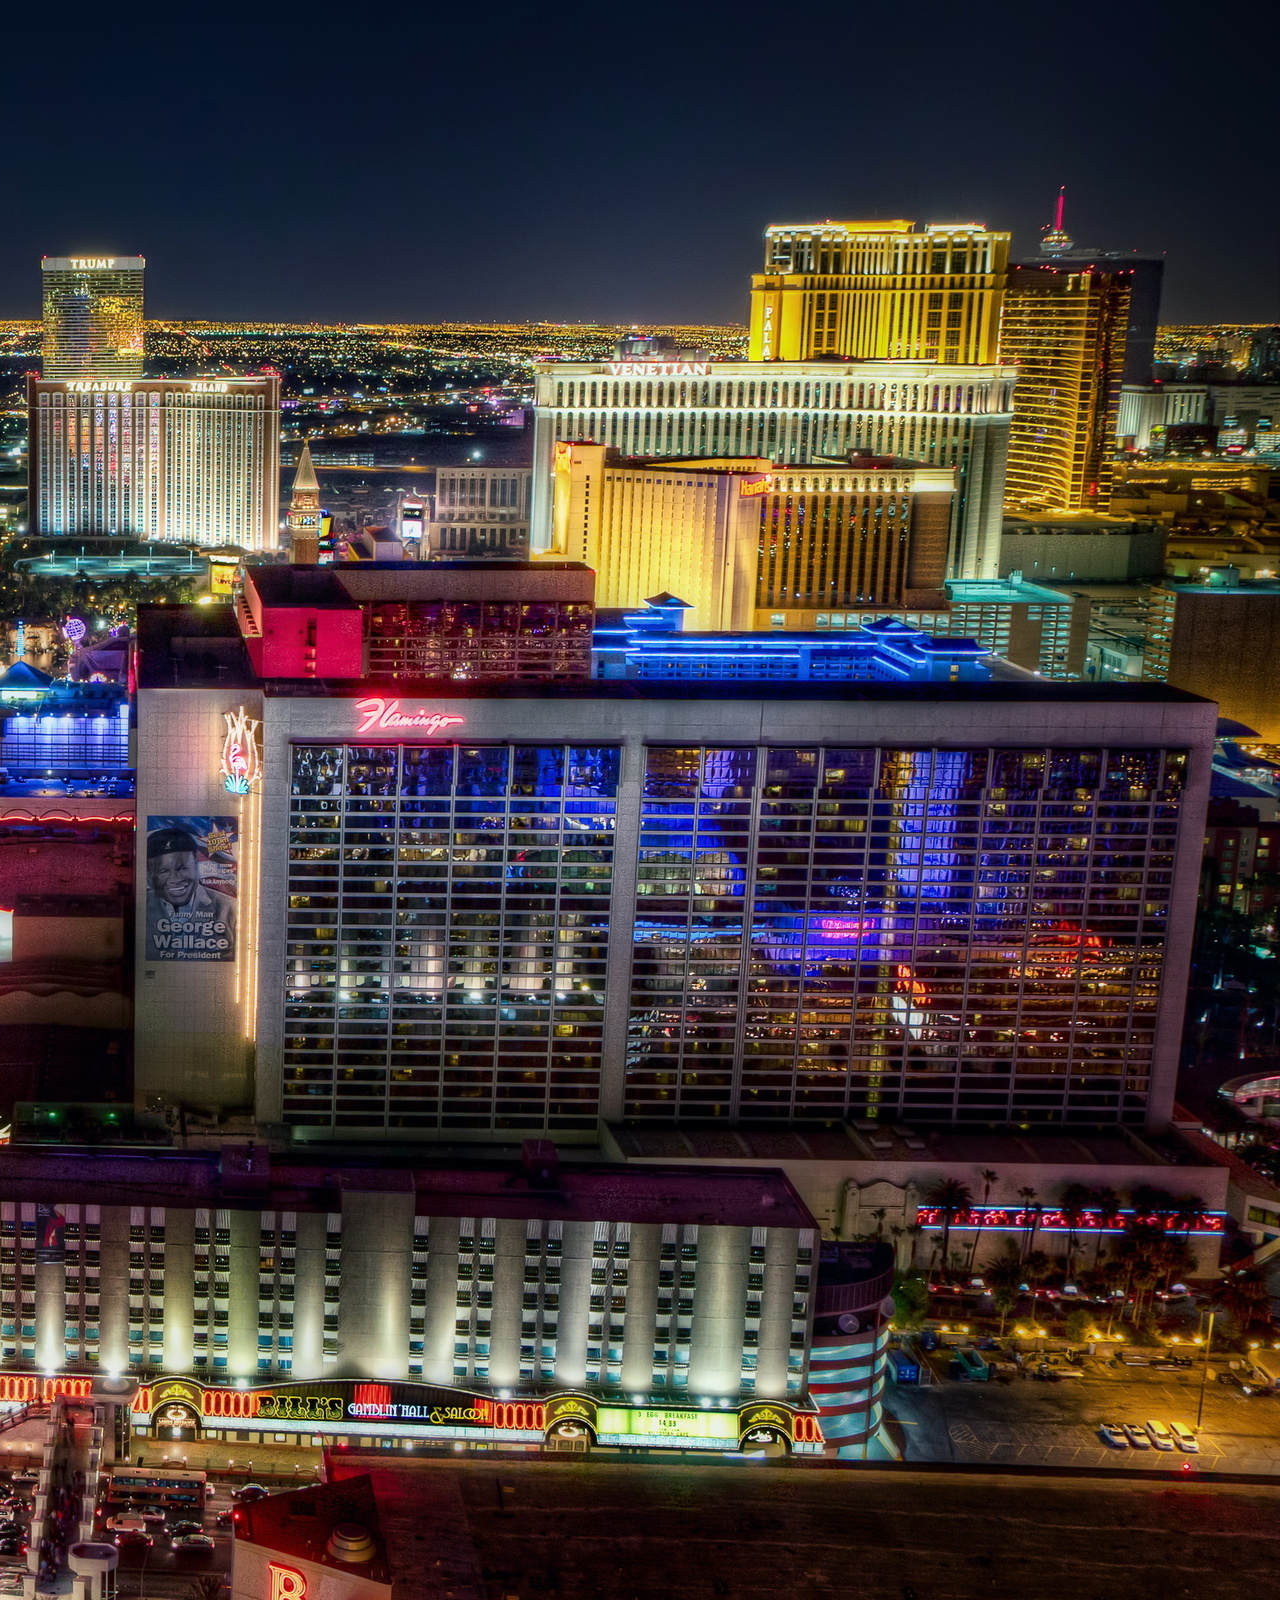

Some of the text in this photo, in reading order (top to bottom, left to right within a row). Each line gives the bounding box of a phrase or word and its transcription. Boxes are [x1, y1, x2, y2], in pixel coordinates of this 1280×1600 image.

[70, 259, 115, 269] TRUMP
[762, 307, 773, 360] PALA
[608, 363, 708, 376] VENETIAN
[66, 382, 228, 392] TREASURE ISLAND
[355, 698, 464, 735] Flamingo
[208, 830, 226, 839] Best
[208, 843, 232, 853] Show!
[169, 911, 192, 919] Funny
[157, 919, 226, 936] George
[153, 935, 229, 949] Wallace
[177, 951, 221, 959] President
[257, 1395, 343, 1420] BILL'S
[348, 1402, 430, 1418] GAMBLIN' HALL
[429, 1406, 489, 1424] & SALOON
[664, 1412, 698, 1420] BREAKFAST
